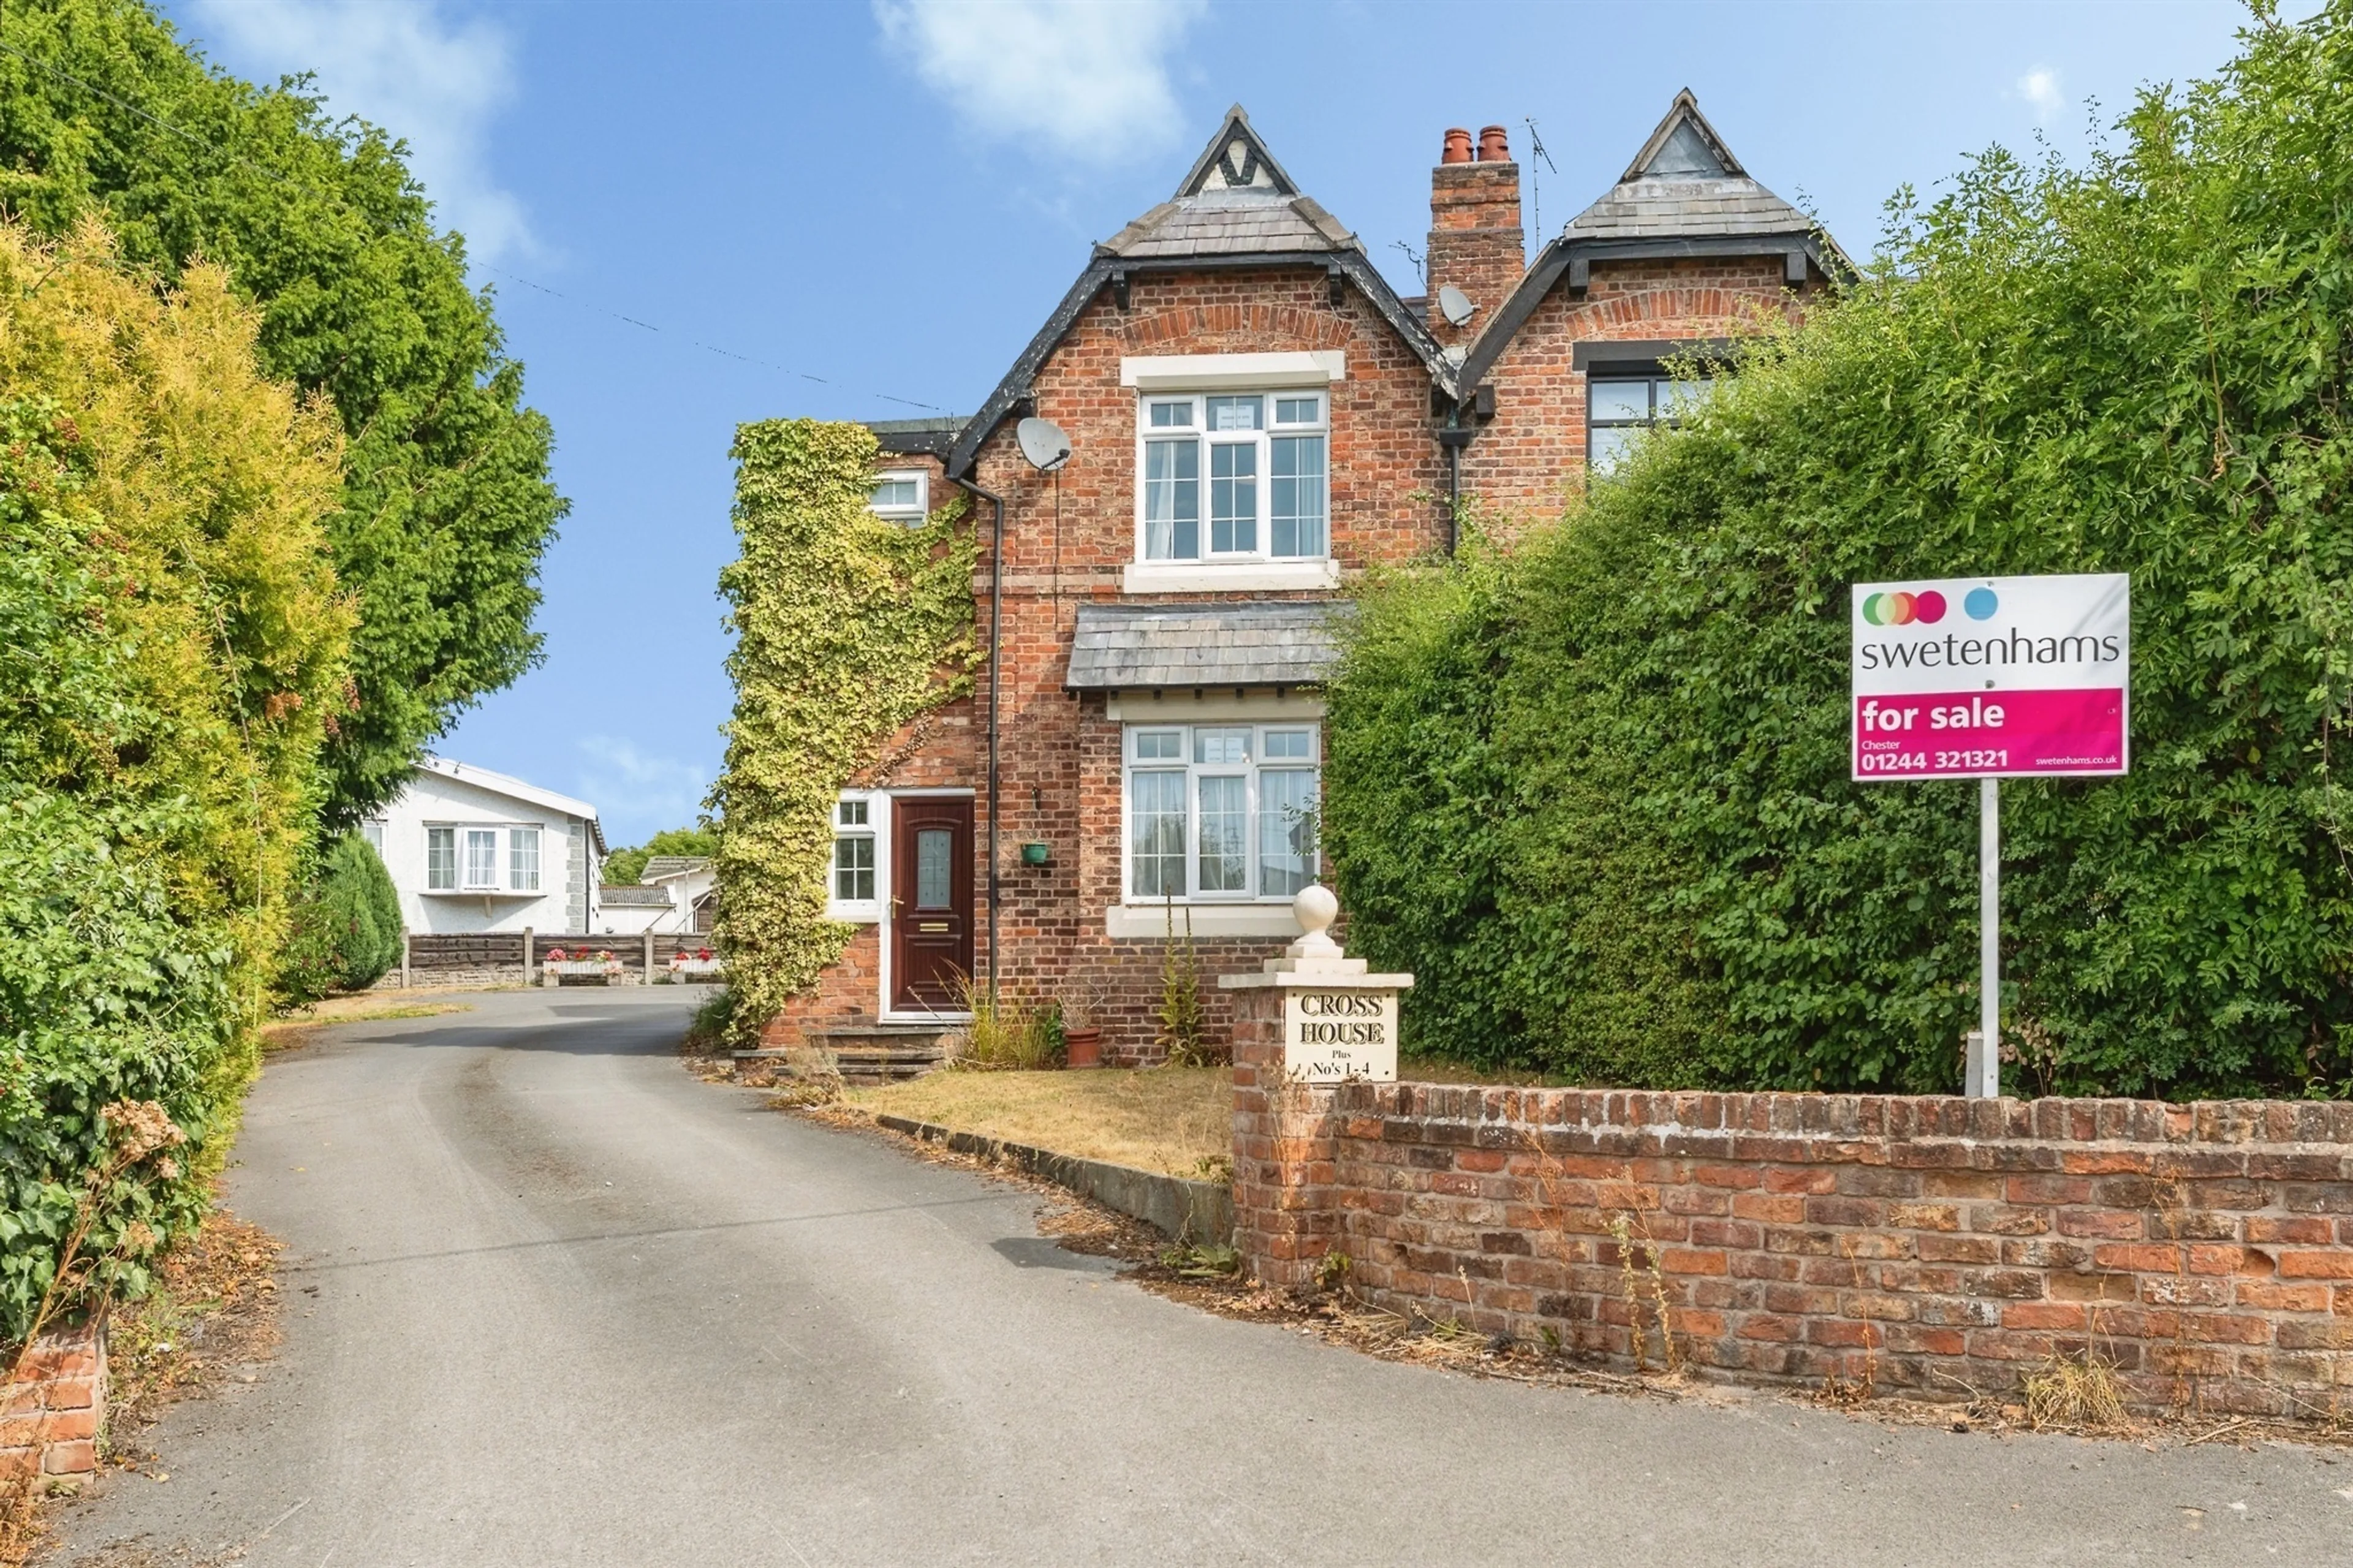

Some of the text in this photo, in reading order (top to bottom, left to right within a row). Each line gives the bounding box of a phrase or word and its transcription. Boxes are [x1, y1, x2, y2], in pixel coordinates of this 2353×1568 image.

[1862, 627, 2120, 669] swetenhams
[1862, 697, 2005, 732] for sale
[1862, 740, 1900, 750] Chester
[1862, 750, 2008, 771] 01244 321321
[2035, 754, 2117, 765] swetenhams.co.uk
[1300, 994, 1383, 1017] CROSS
[1300, 1022, 1385, 1045] HOUSE
[1332, 1050, 1351, 1059] Plus
[1313, 1062, 1341, 1075] No's
